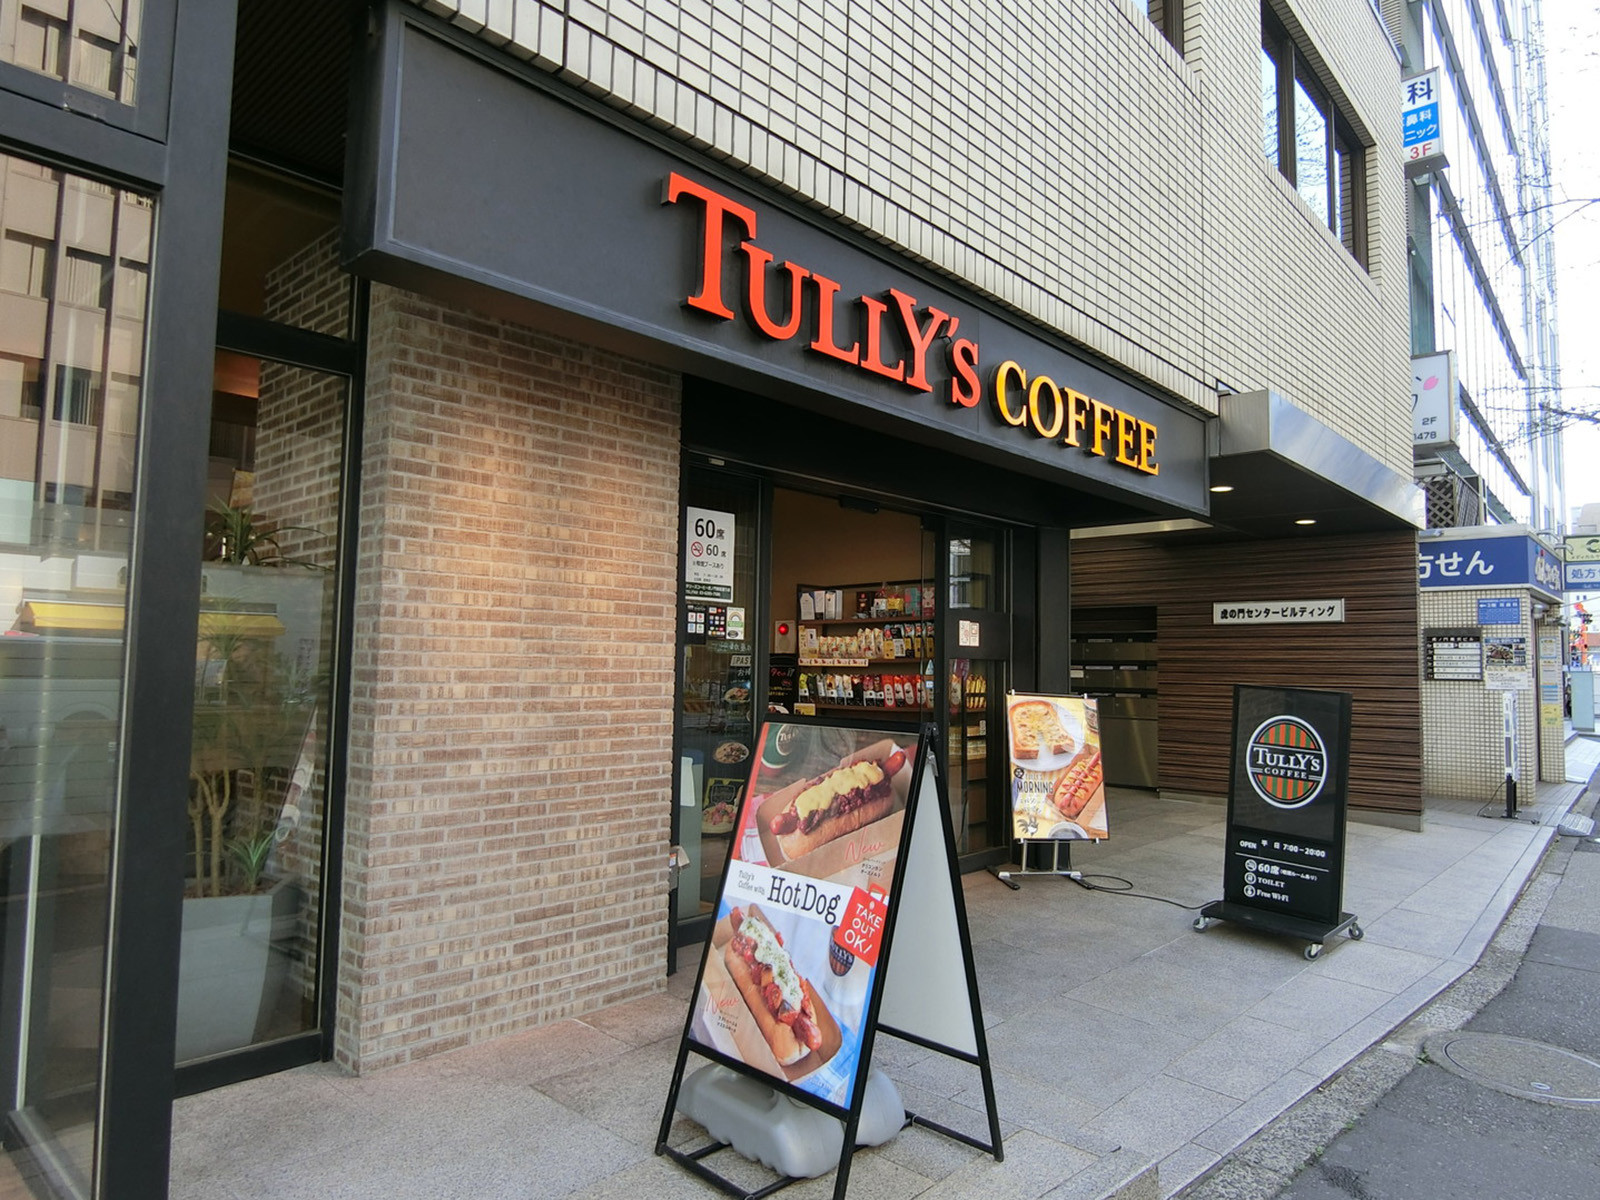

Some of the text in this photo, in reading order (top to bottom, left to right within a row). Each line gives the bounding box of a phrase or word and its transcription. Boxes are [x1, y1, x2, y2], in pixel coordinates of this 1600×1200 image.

[1410, 142, 1432, 160] 3F
[666, 170, 1160, 476] TULLY'S COFFEE
[1422, 416, 1437, 426] 2F
[1253, 746, 1321, 772] TULLY'S
[1264, 767, 1308, 780] COFFEE
[1016, 781, 1054, 794] MORNING
[844, 825, 886, 862] New
[1239, 840, 1258, 850] OPEN
[738, 868, 755, 882] Tully's
[1257, 876, 1286, 888] TOILET
[1256, 889, 1271, 899] Free
[855, 903, 884, 929] TAKE
[851, 917, 876, 939] OUT
[843, 928, 872, 955] OK!
